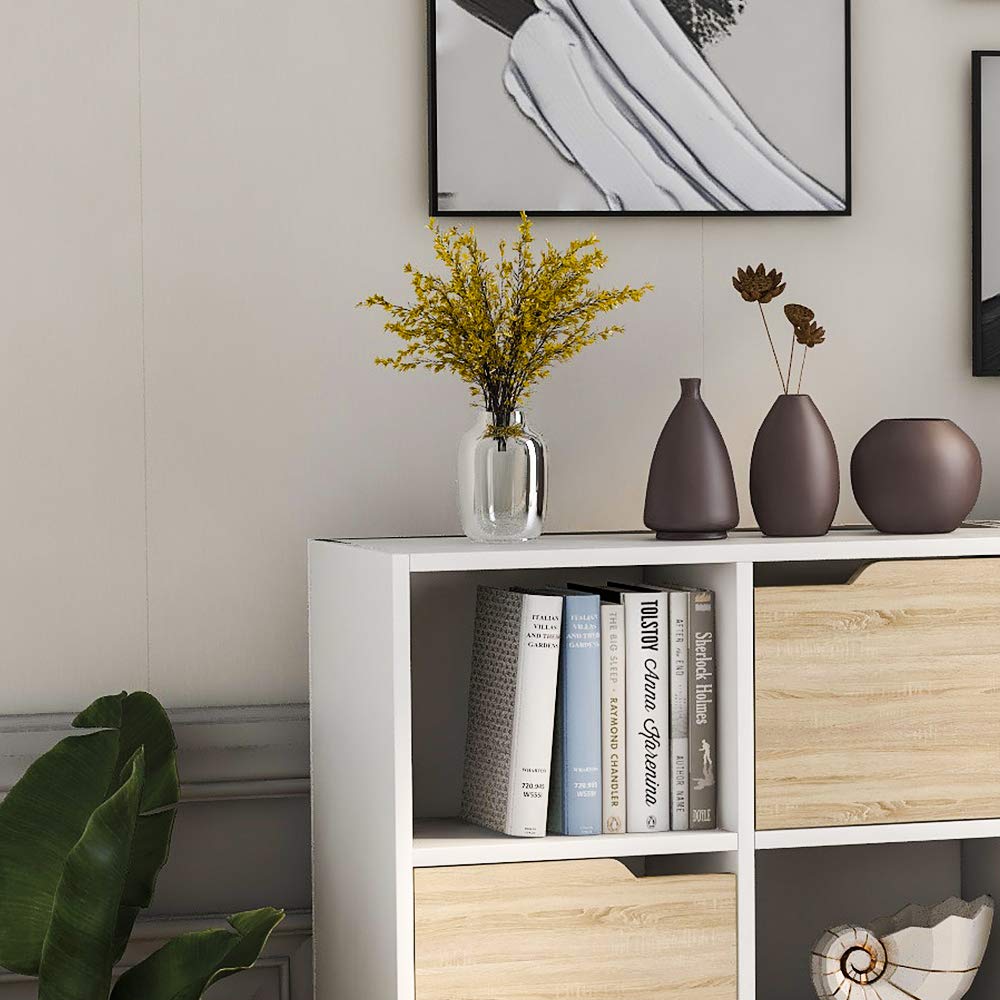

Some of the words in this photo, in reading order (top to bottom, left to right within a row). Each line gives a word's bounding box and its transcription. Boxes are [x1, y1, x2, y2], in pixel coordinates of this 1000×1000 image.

[609, 611, 617, 631] THE
[609, 635, 618, 653] BIG
[641, 600, 659, 651] TOLSTOY
[609, 655, 618, 684] SLEEP
[695, 632, 713, 680] Sherlock
[644, 658, 660, 713] Anna
[695, 684, 713, 725] Holmes
[610, 697, 619, 750] RAYMOND
[610, 753, 619, 808] CHANDLER
[638, 718, 661, 807] Karenina
[675, 755, 685, 786] AUTHOR
